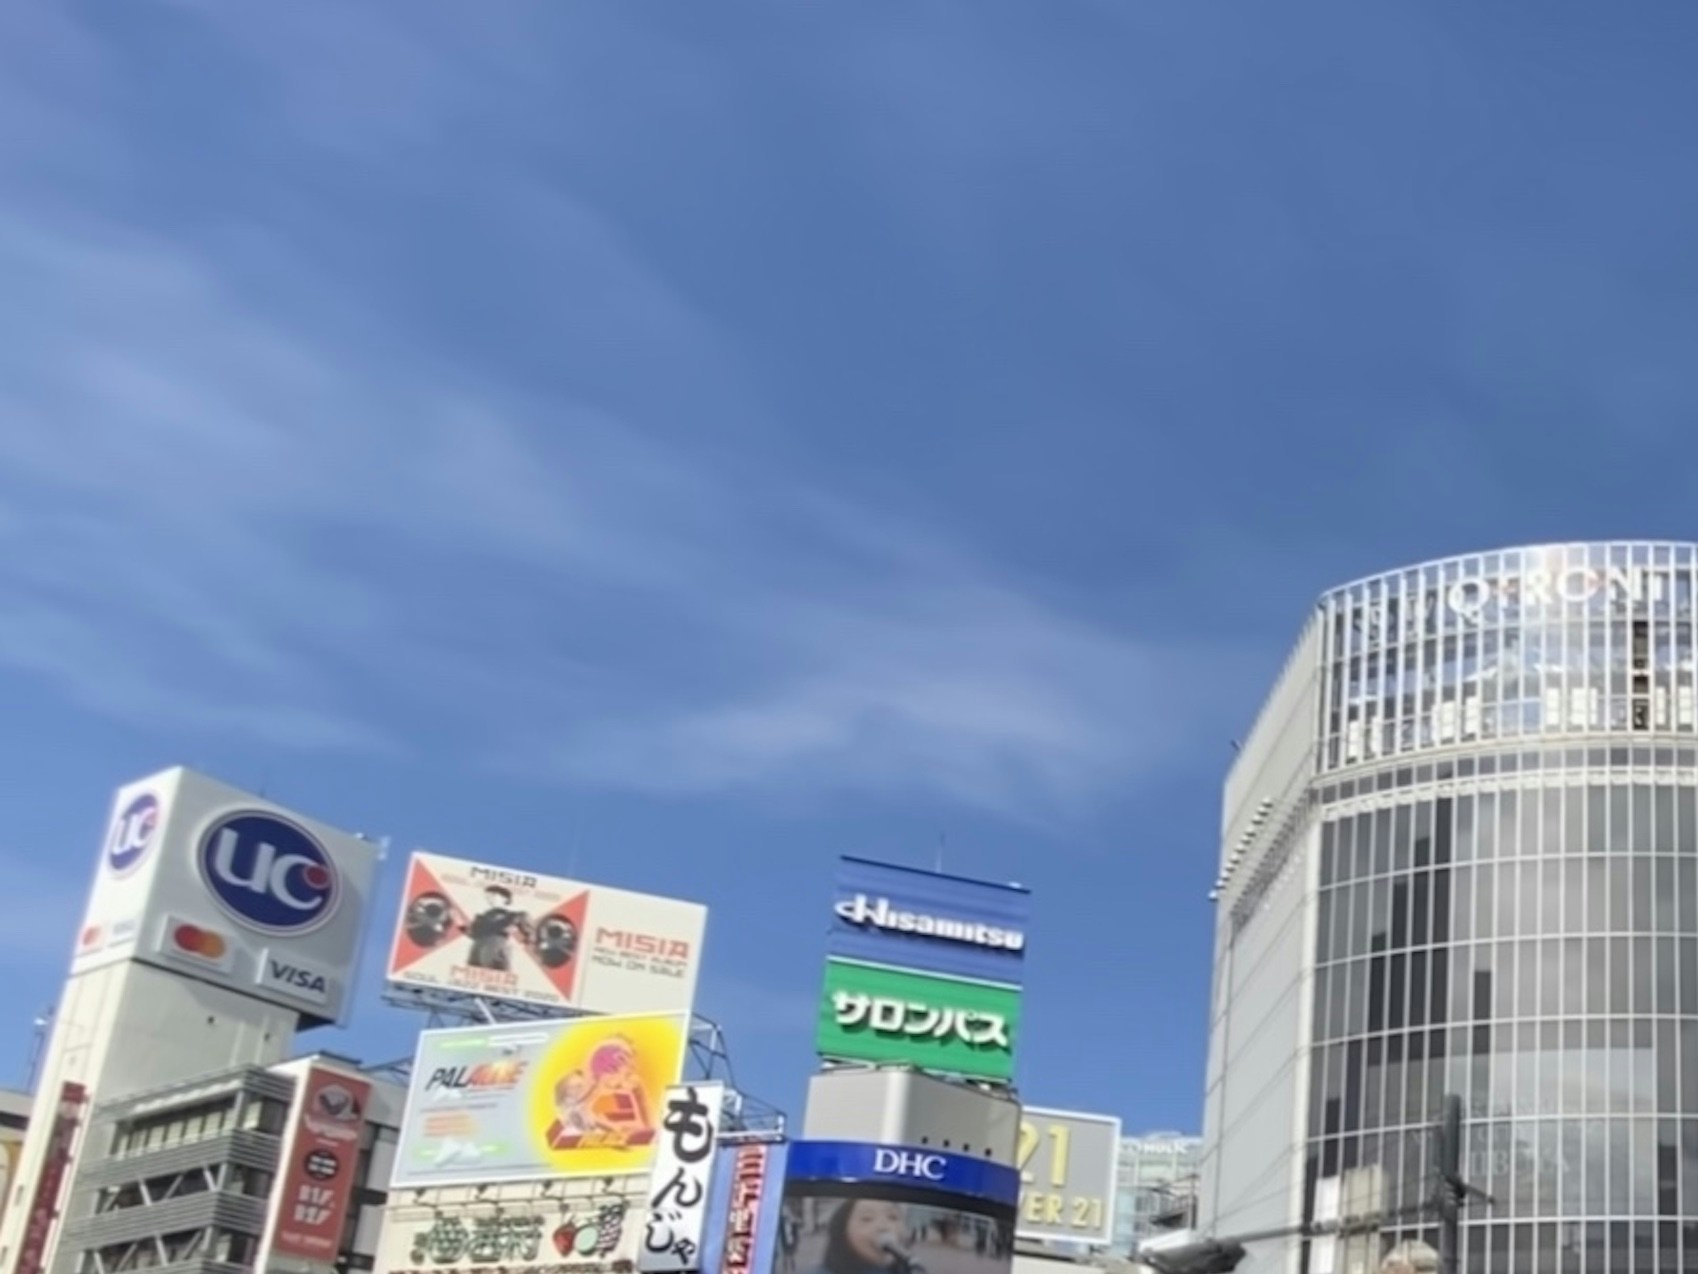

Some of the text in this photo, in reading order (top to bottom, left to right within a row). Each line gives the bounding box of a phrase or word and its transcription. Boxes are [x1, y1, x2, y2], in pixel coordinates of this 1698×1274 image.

[213, 825, 327, 912] UC
[470, 865, 536, 889] MISIA
[836, 893, 1024, 951] Hisamitsu
[594, 926, 690, 960] MISIA
[269, 959, 327, 994] VISA
[449, 964, 519, 988] MISIA
[832, 988, 1010, 1048] サロンパス
[643, 1085, 715, 1266] もんじゃ
[872, 1147, 947, 1182] DHC
[1071, 1195, 1103, 1228] 21
